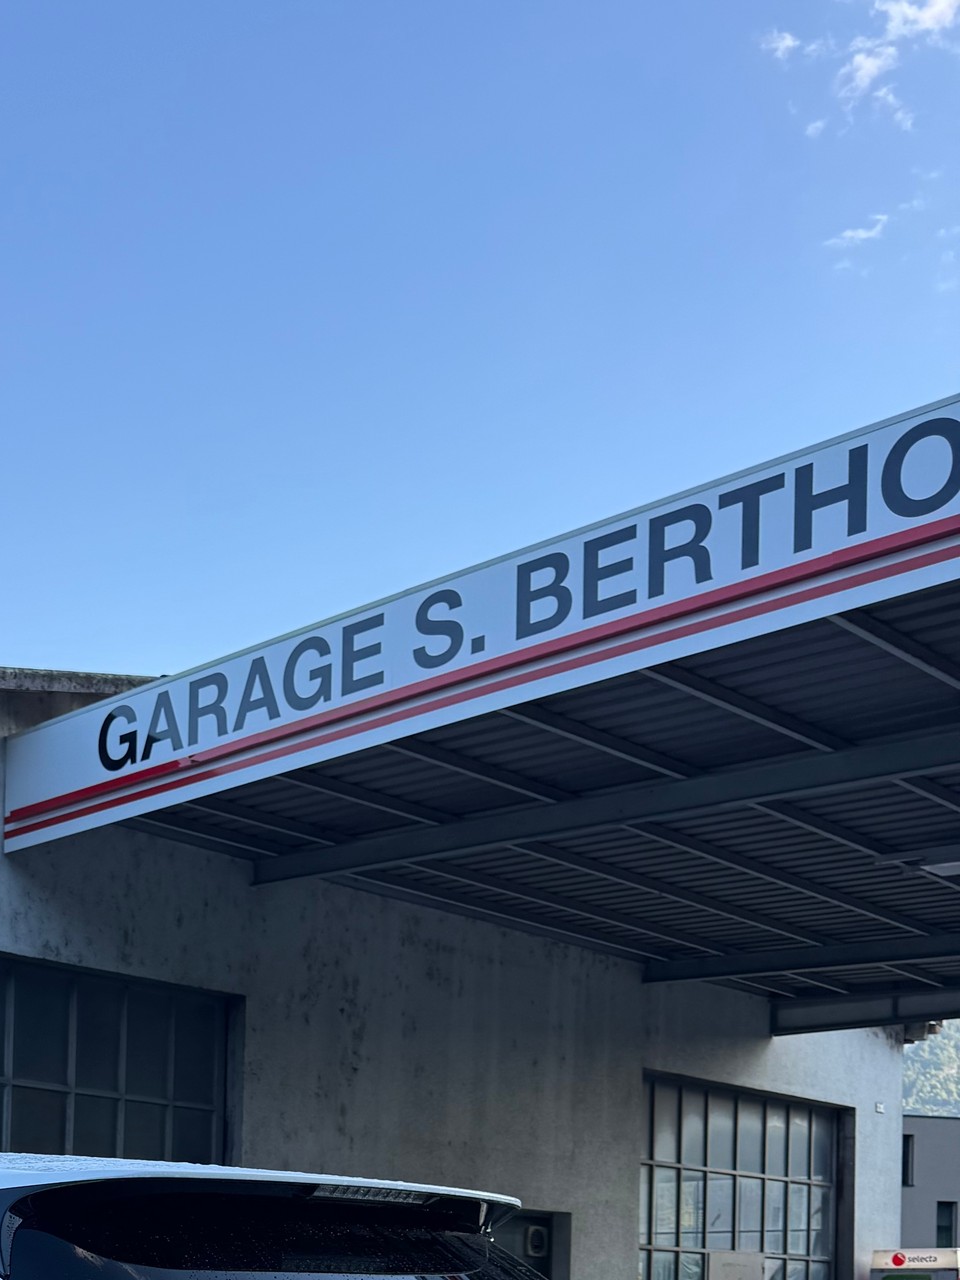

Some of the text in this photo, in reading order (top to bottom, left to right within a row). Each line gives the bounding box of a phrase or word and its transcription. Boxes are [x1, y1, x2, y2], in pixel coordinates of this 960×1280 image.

[98, 416, 960, 773] GARAGE S. BERTHO
[907, 1255, 938, 1263] selecta
